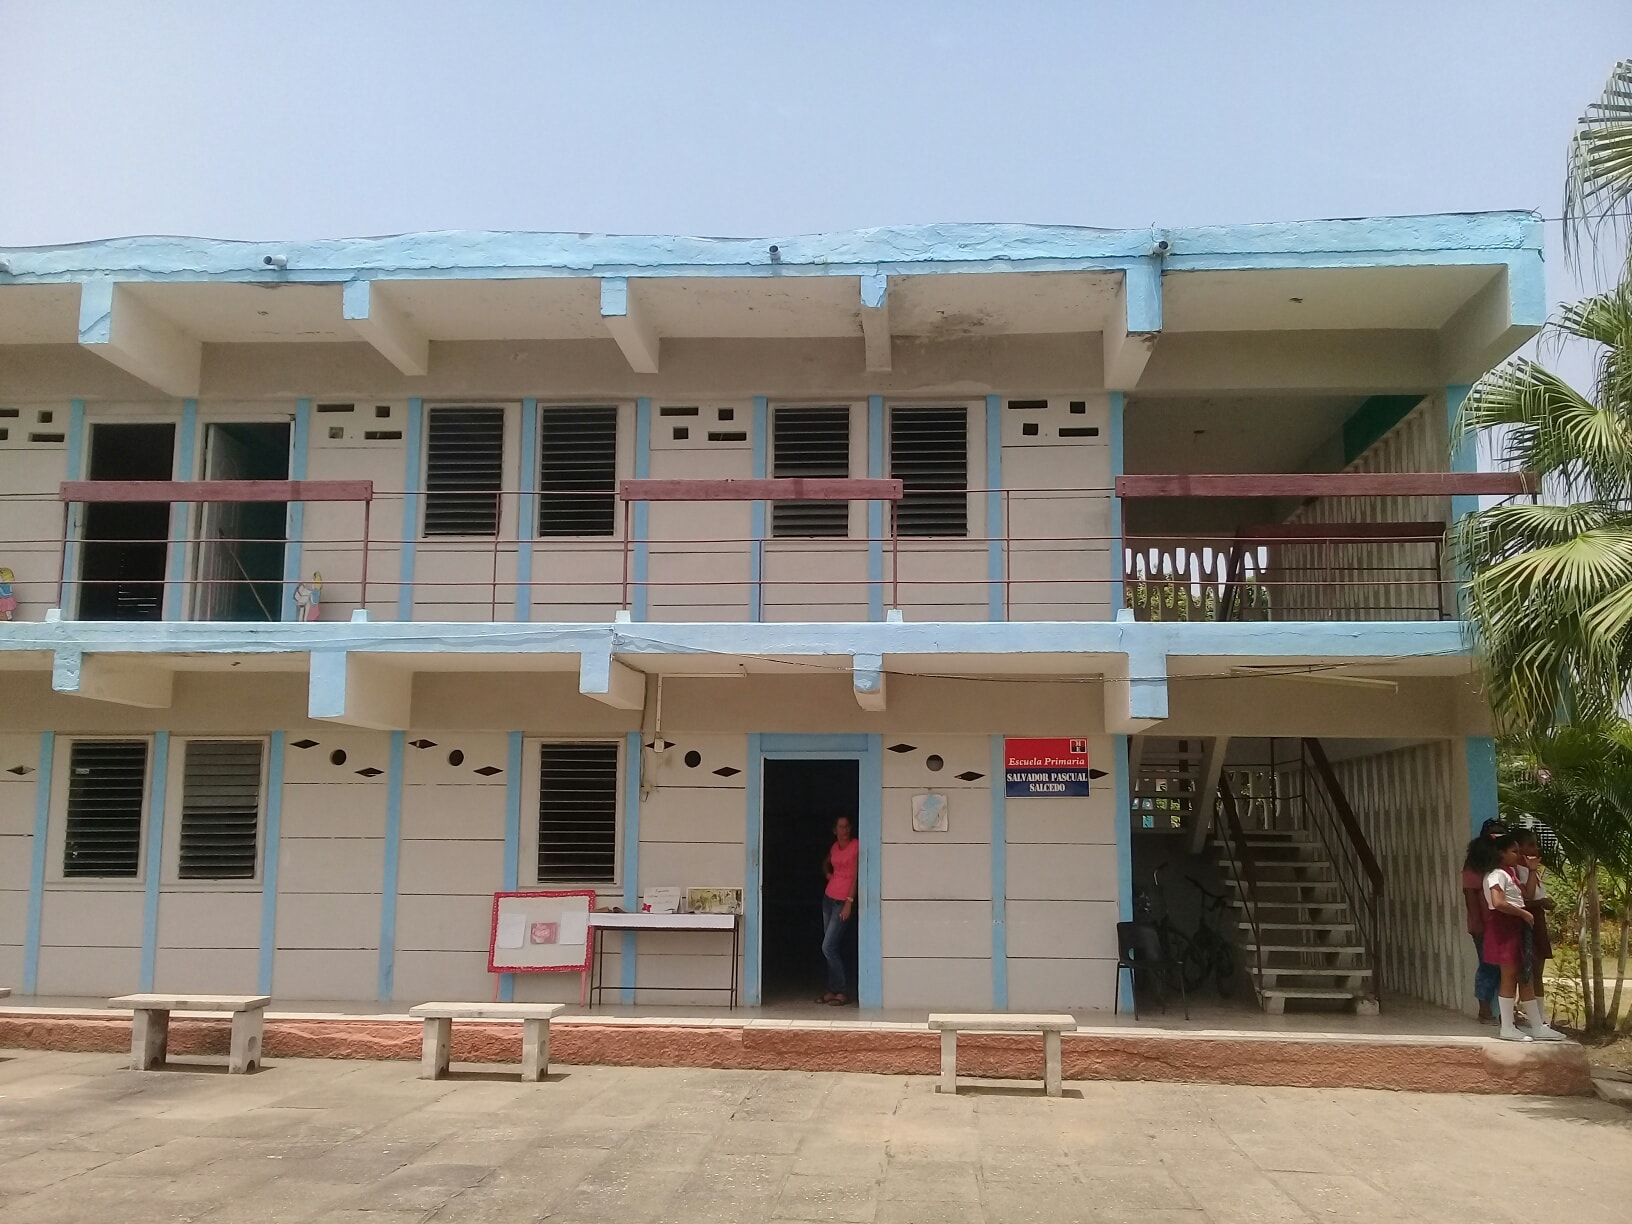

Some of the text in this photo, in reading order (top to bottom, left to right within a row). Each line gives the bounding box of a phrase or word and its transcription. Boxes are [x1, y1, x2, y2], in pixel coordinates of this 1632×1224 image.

[1008, 758, 1085, 766] Escuela Primaria
[1007, 772, 1088, 782] SALVADOR PASCUAL
[1029, 783, 1065, 792] SALCEDO
